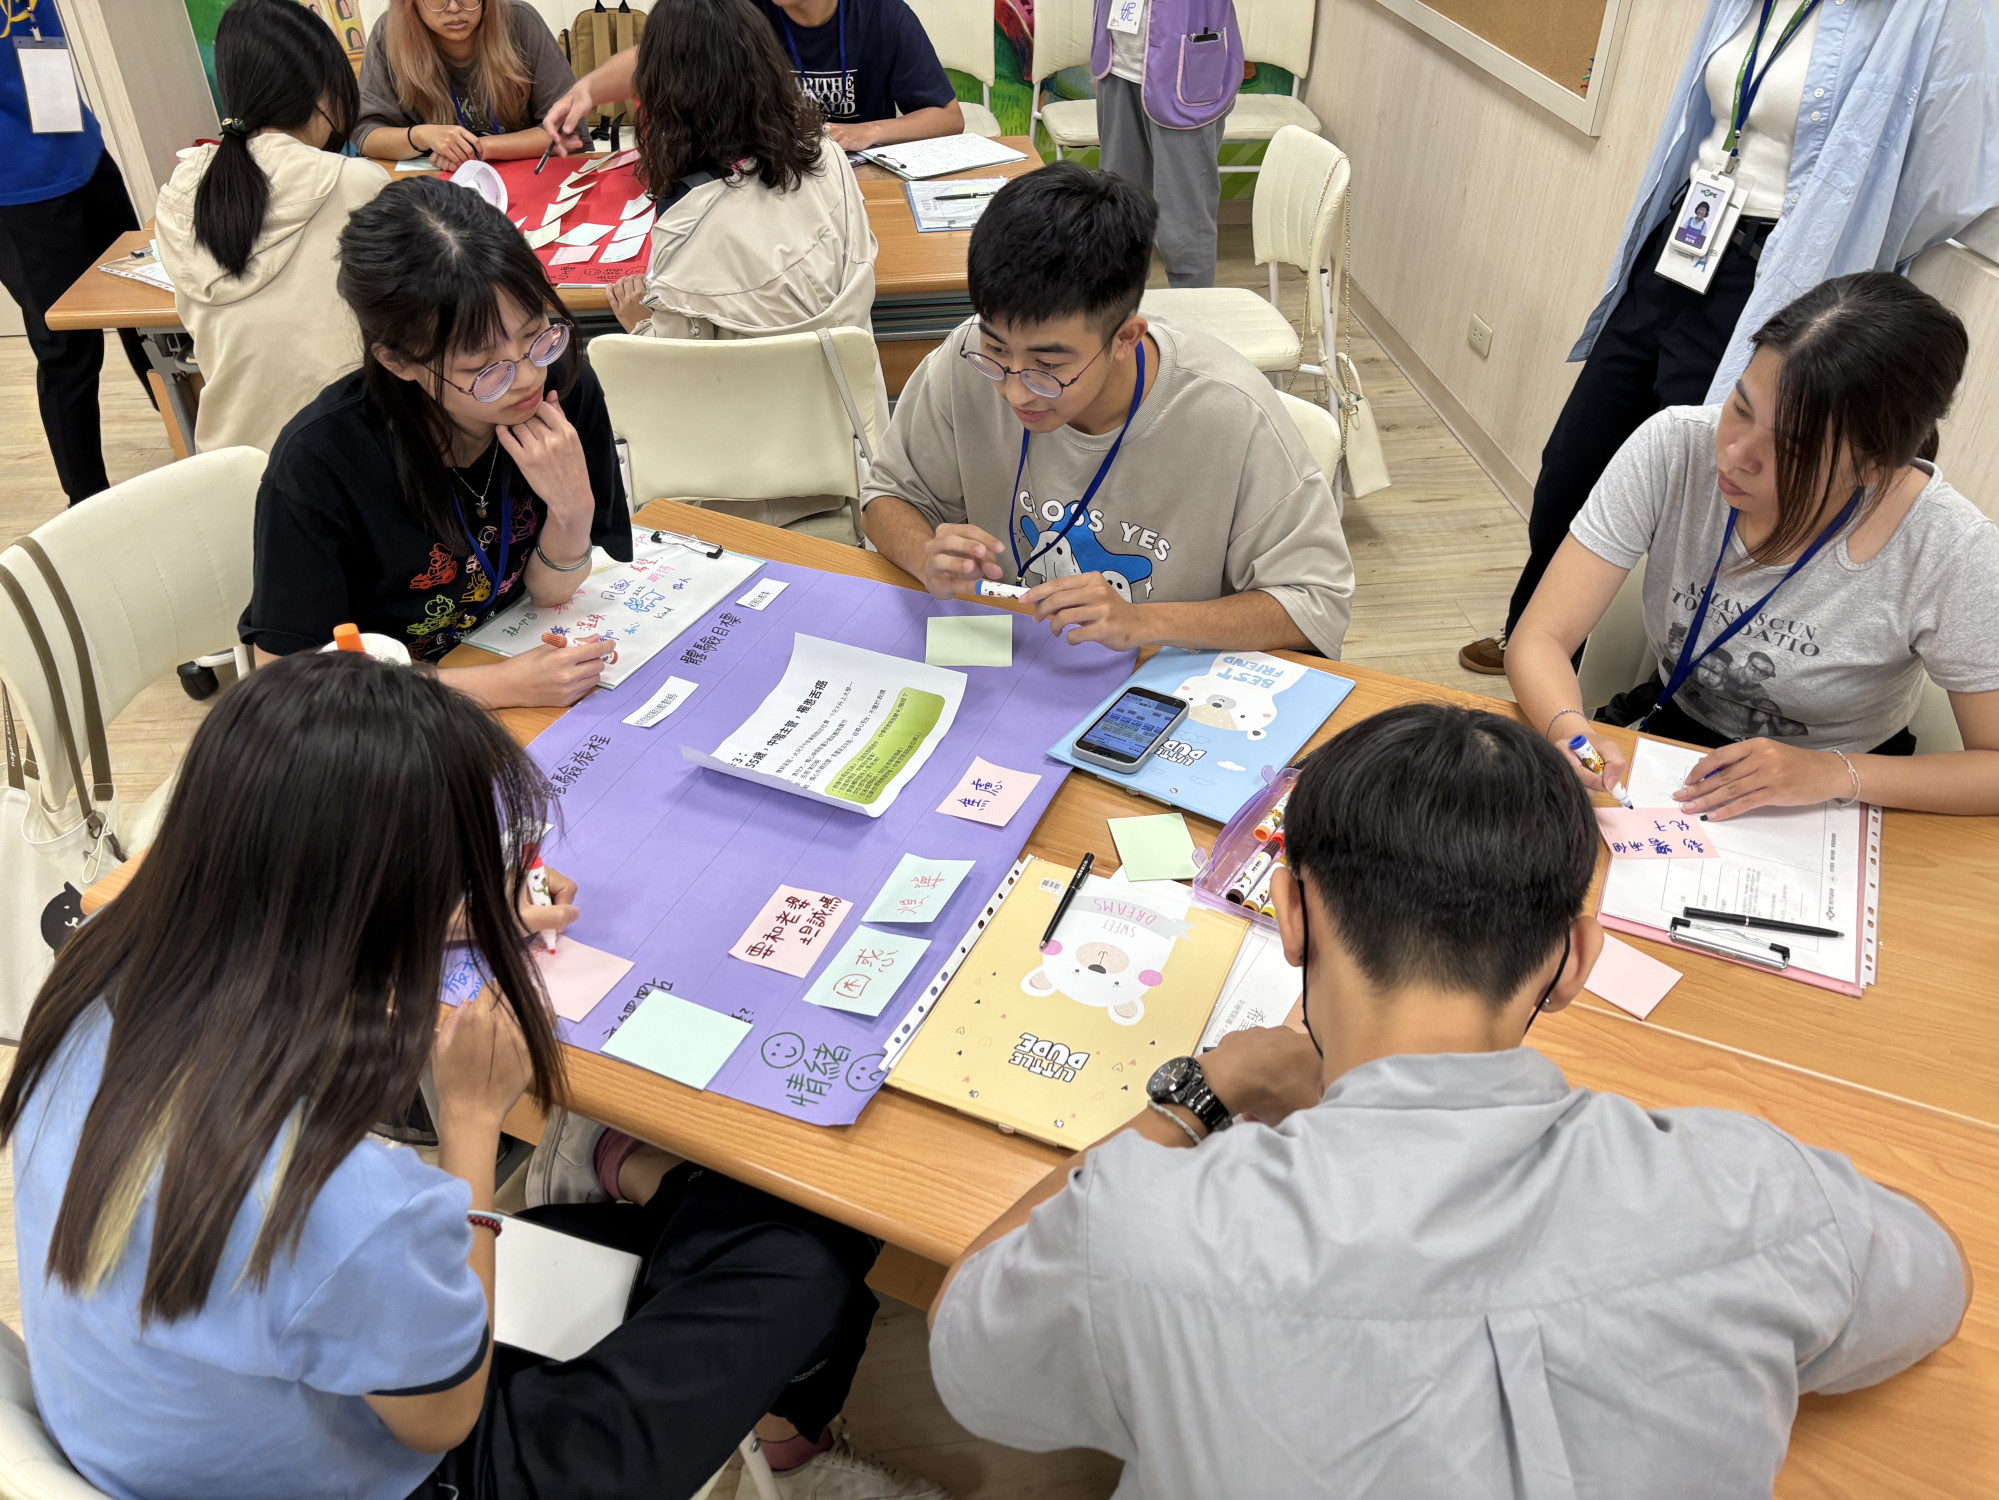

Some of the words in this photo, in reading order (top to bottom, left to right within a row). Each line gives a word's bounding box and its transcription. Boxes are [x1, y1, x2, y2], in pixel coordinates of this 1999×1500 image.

[1119, 520, 1171, 561] YES
[680, 612, 742, 666] 體驗目標
[1216, 667, 1276, 689] BEST
[1222, 655, 1285, 678] FRIEND
[1158, 737, 1206, 761] DUD
[745, 894, 812, 961] 要和老婆
[797, 895, 843, 949] 坦誠嗎
[1093, 898, 1158, 926] DREAMS
[1101, 918, 1137, 938] SWEET
[834, 947, 898, 1000] 困惑
[1008, 1050, 1077, 1084] LITTLE
[1014, 1032, 1091, 1071] DUDE
[785, 1038, 852, 1107] 情緒
